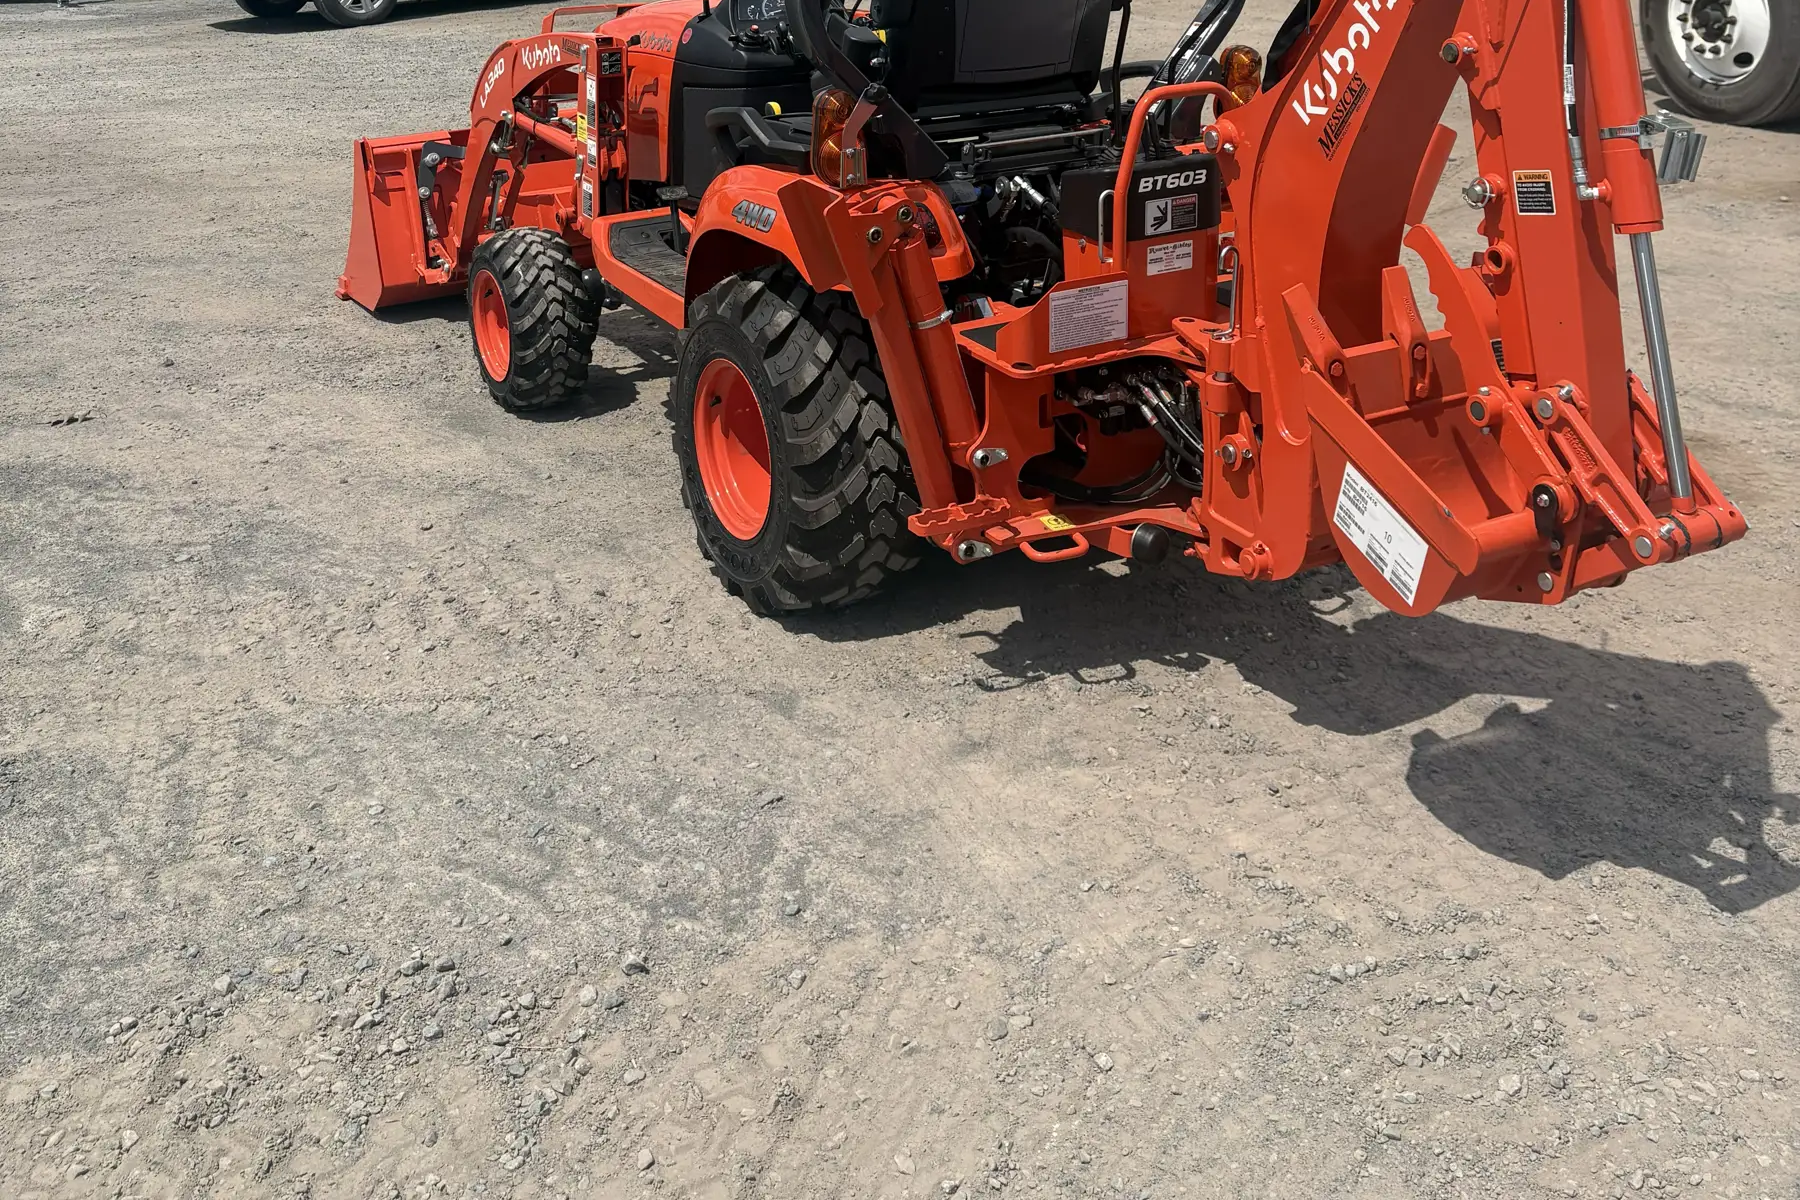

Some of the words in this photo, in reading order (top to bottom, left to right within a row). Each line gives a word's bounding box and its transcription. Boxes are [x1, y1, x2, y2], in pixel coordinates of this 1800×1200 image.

[521, 39, 561, 70] Kubota
[639, 30, 673, 52] Kubota
[480, 57, 505, 109] LA340
[1317, 71, 1363, 159] MESSICK'S
[1138, 169, 1208, 193] BT603
[1176, 196, 1196, 204] DANGER
[731, 199, 777, 233] 4WD
[1383, 531, 1392, 544] 10
